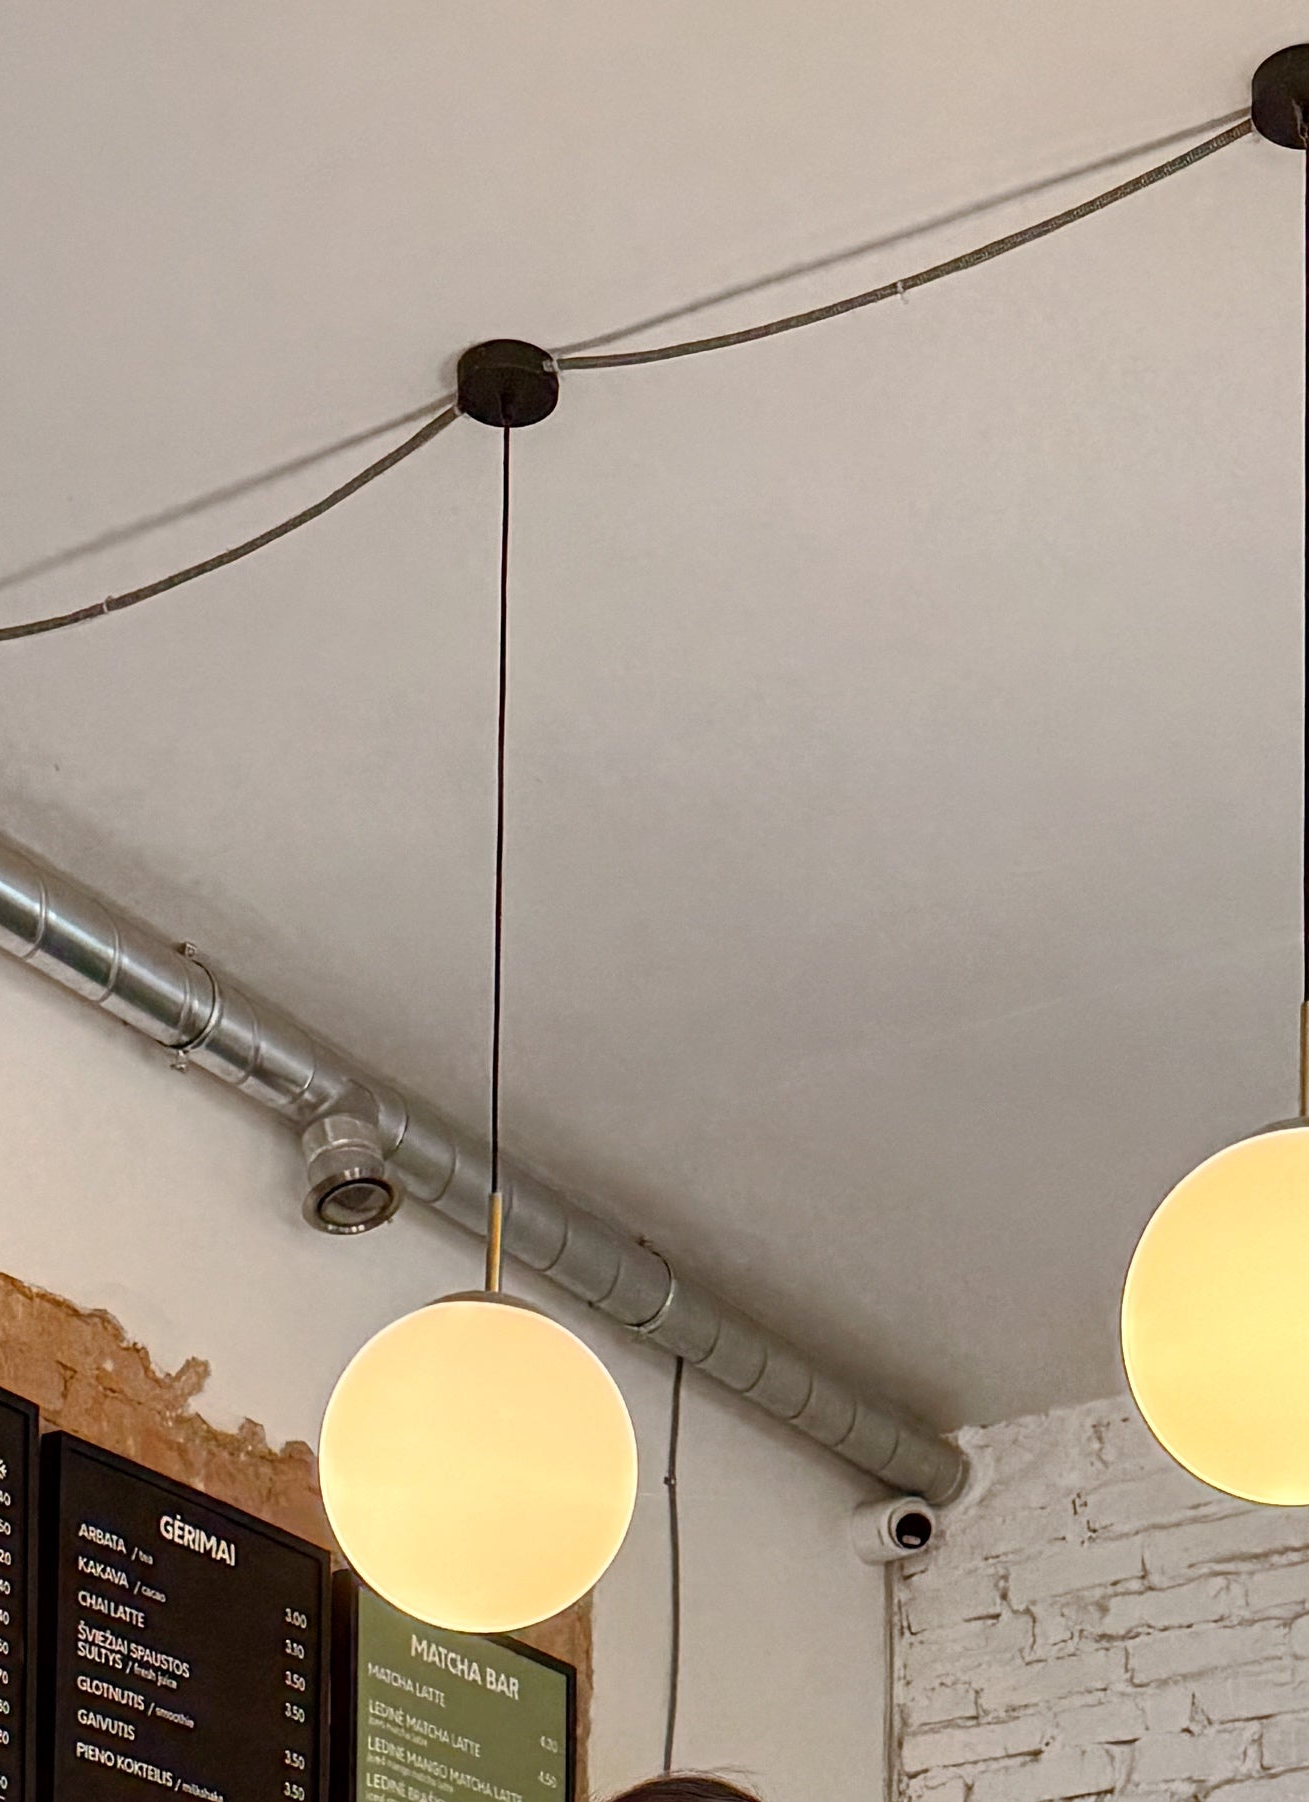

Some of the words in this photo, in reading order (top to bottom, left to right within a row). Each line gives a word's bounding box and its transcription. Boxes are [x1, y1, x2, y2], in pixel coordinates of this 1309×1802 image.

[160, 1516, 235, 1566] GĖRIMAI
[78, 1556, 129, 1588] KAKAVA
[78, 1524, 126, 1554] ARBATA
[285, 1608, 307, 1629] 3.00
[78, 1591, 108, 1614] CHAI
[110, 1602, 144, 1628] LATTE
[285, 1671, 305, 1691] 3.50
[130, 1643, 189, 1678] SPAUSTOS
[77, 1641, 122, 1669] SULTYS
[285, 1702, 305, 1723] 3.50
[368, 1662, 414, 1693] MATCHA
[416, 1683, 445, 1707] LATTE
[411, 1634, 482, 1685] MATCHA
[486, 1667, 519, 1700] BAR
[77, 1676, 144, 1710] GLOTNUTIS
[285, 1750, 305, 1770] 3.50
[406, 1714, 449, 1743] MATCHA
[452, 1734, 480, 1757] LATTE
[76, 1742, 115, 1766] PIENO
[117, 1755, 173, 1787] KOKTEILIS
[78, 1709, 135, 1740] GAIVUTIS
[284, 1782, 305, 1801] 3.50
[450, 1768, 492, 1797] MATCHA
